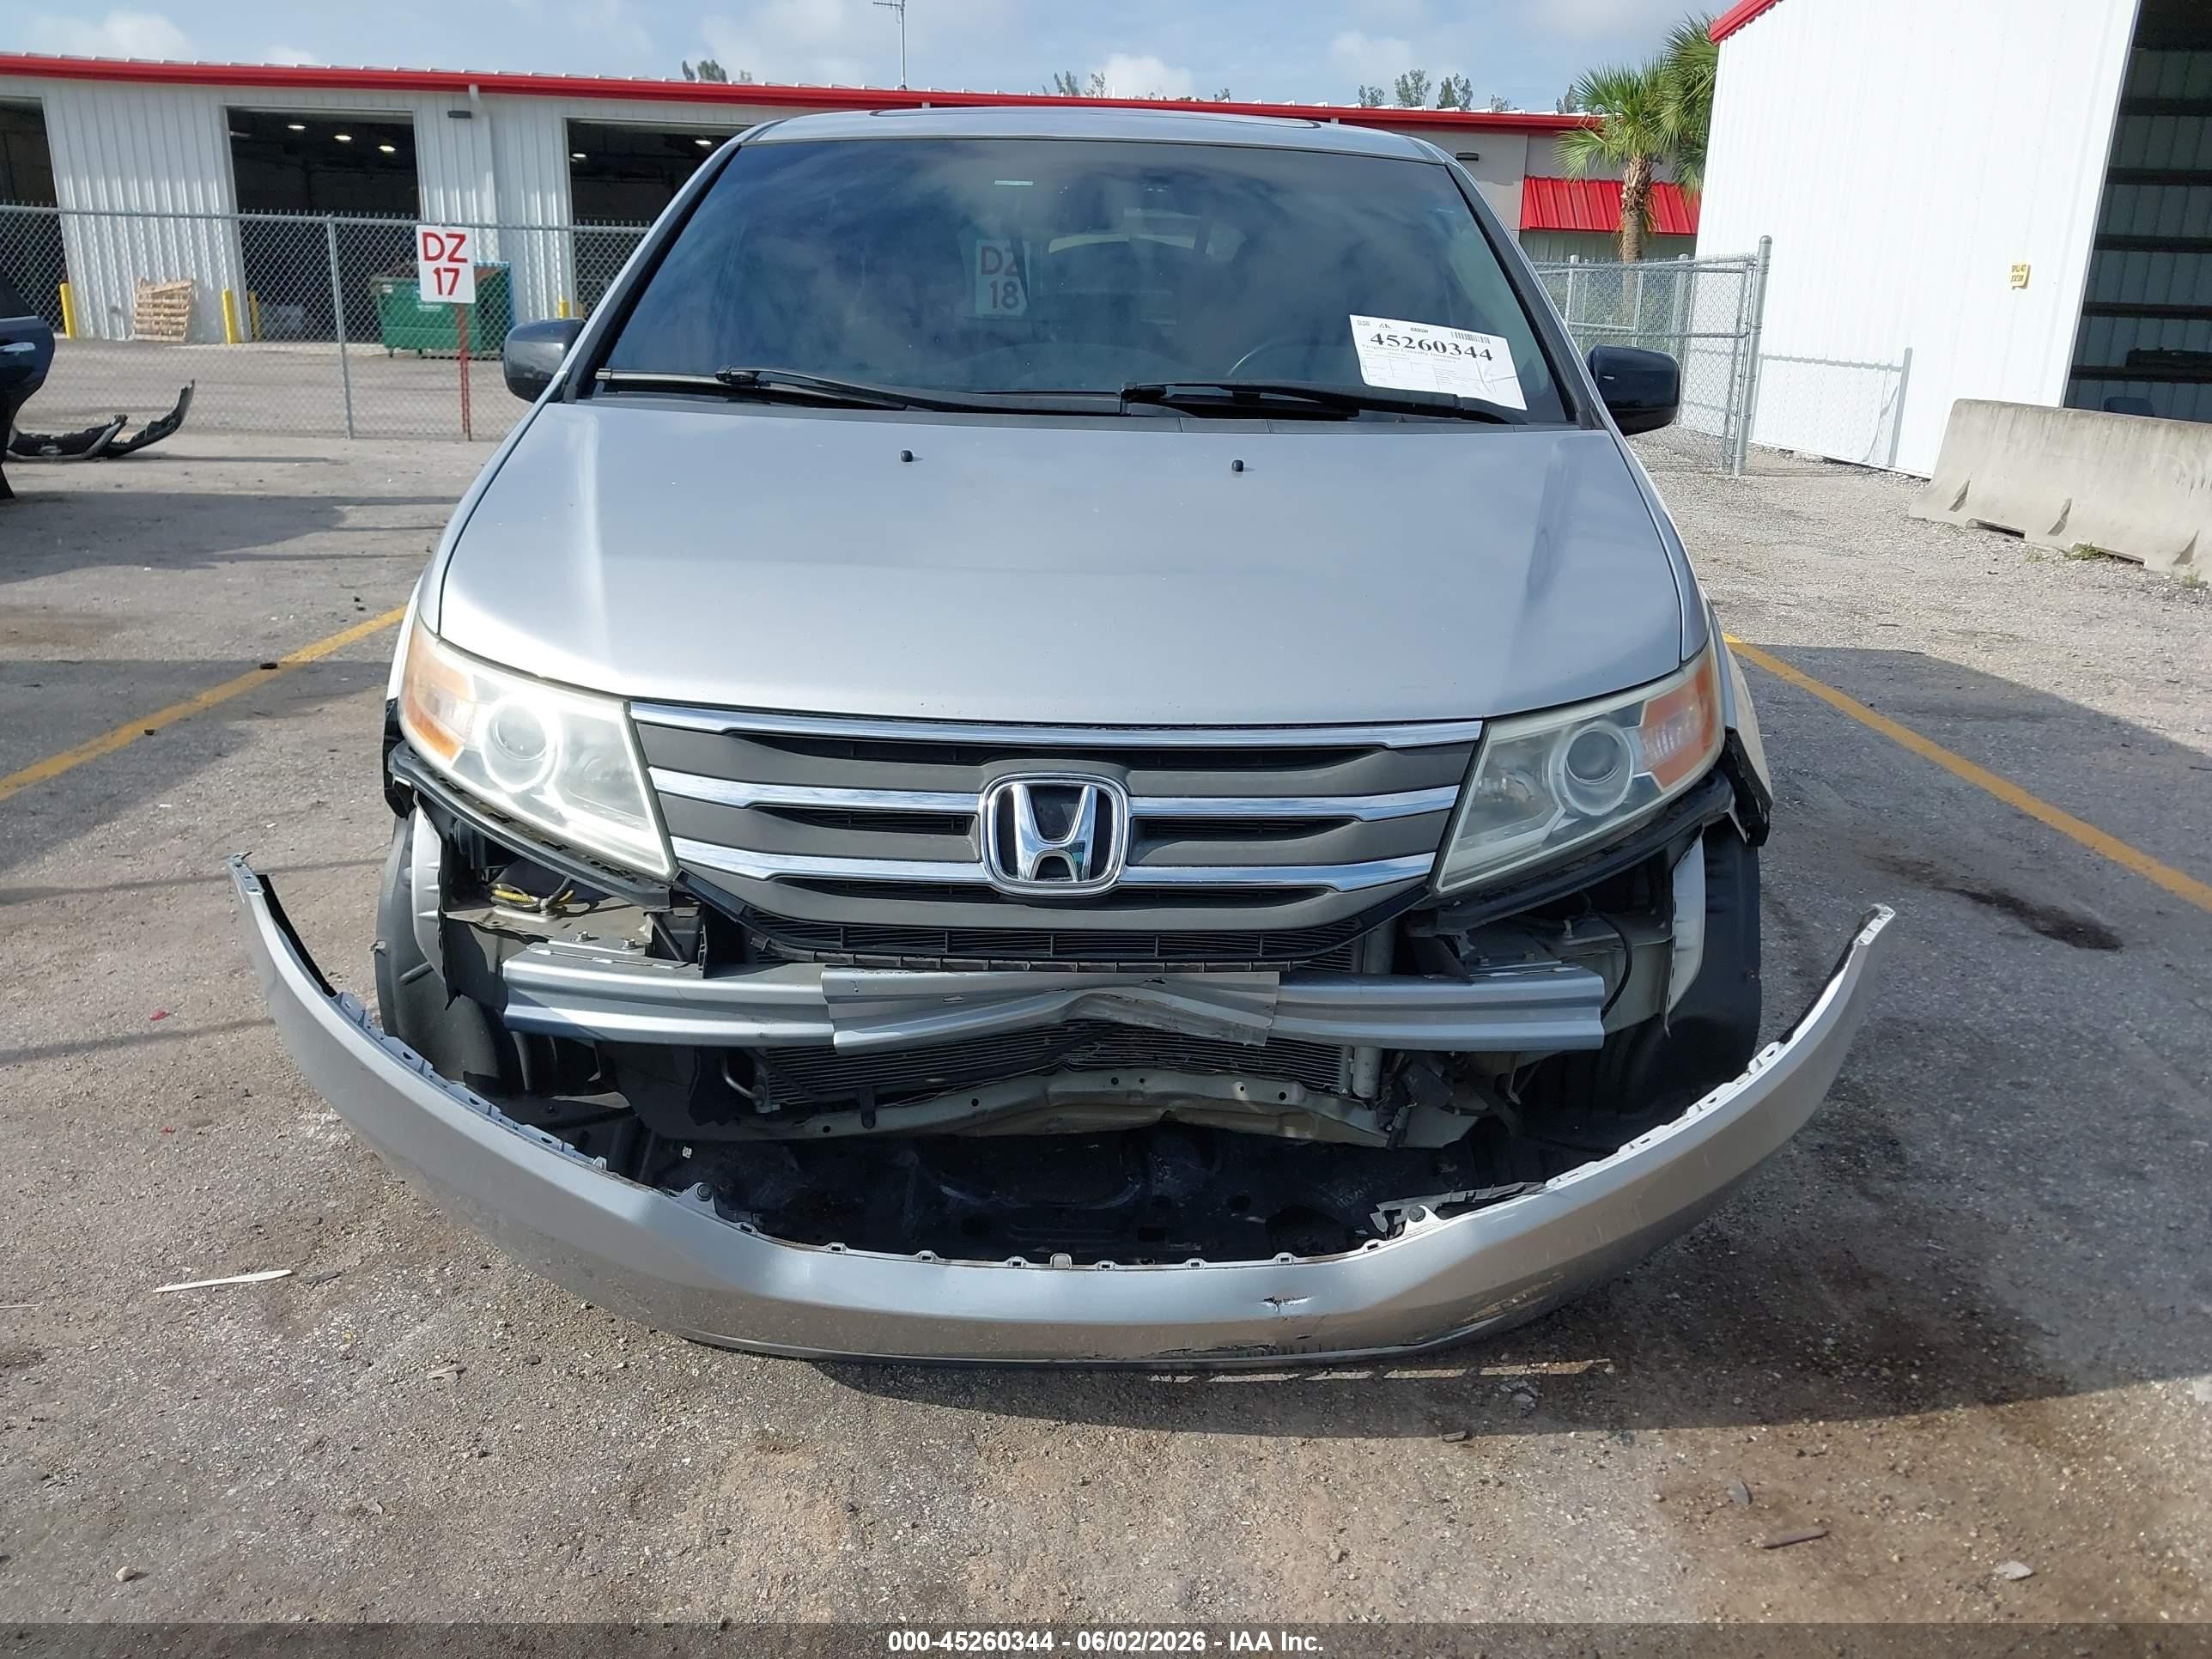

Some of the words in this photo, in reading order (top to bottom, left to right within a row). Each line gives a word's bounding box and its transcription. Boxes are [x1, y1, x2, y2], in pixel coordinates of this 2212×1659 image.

[422, 232, 468, 263] DZ
[433, 267, 459, 295] 17
[989, 281, 1019, 309] 18
[1370, 332, 1492, 362] 45260344
